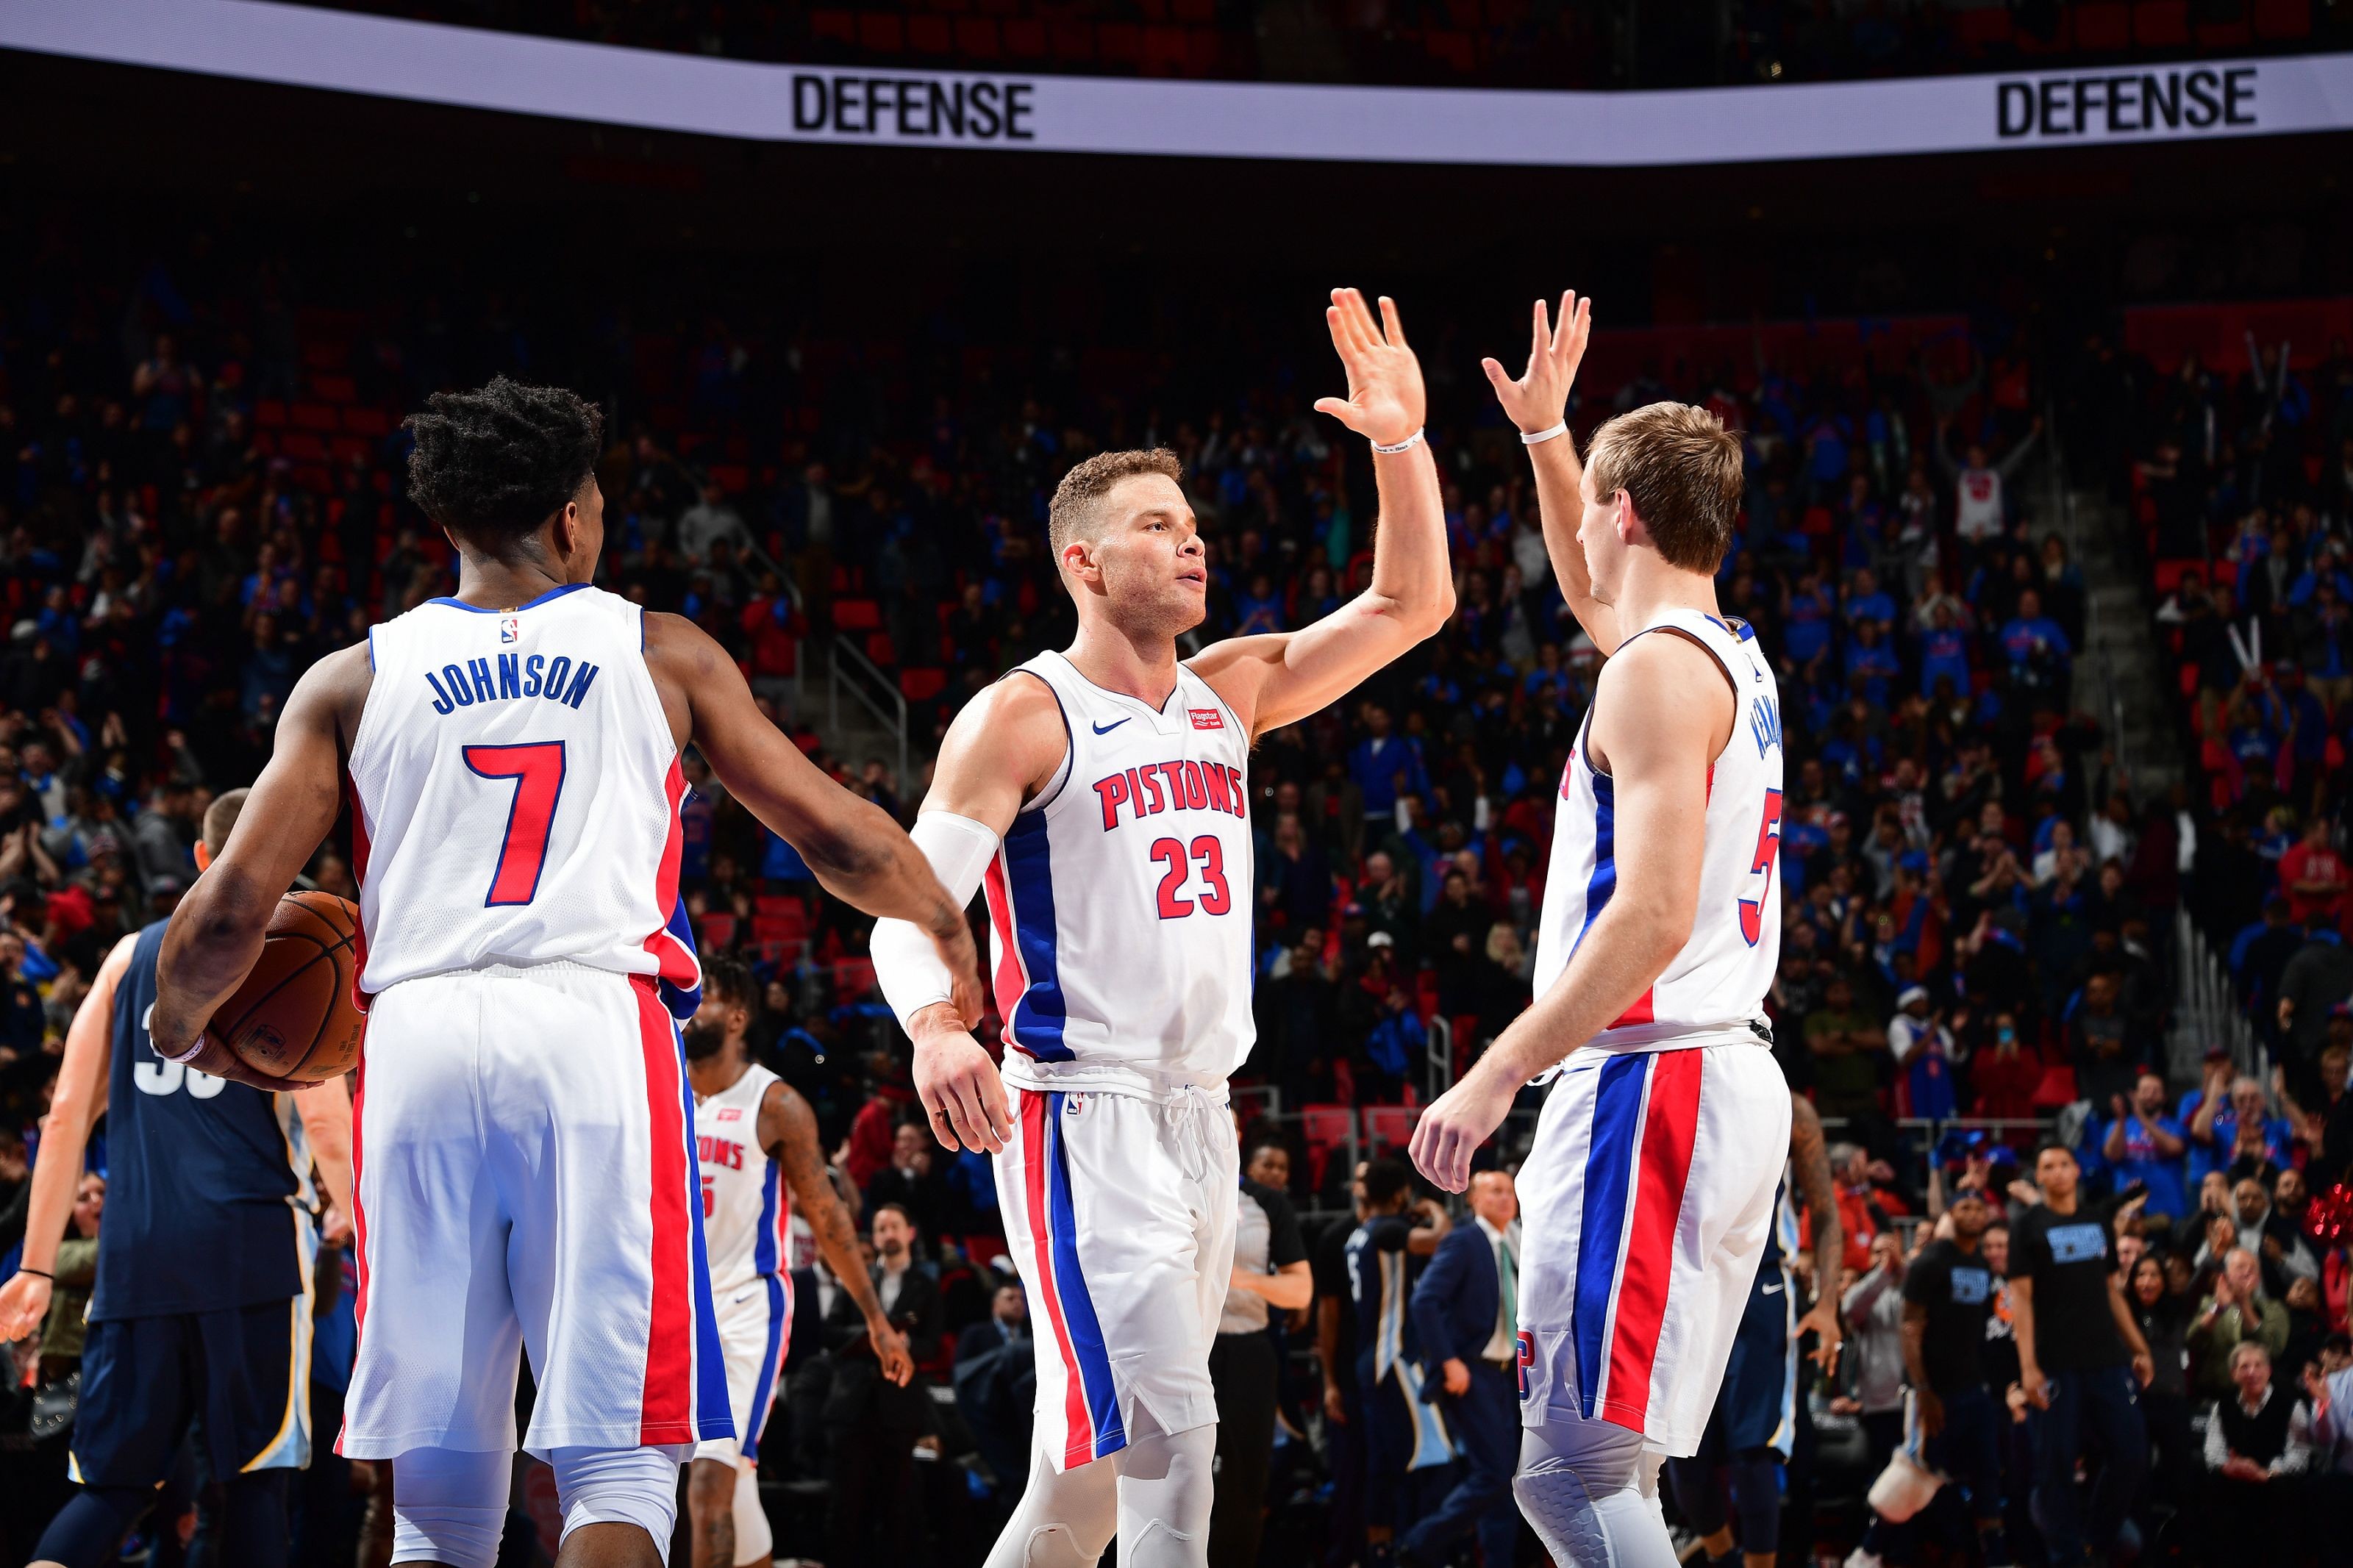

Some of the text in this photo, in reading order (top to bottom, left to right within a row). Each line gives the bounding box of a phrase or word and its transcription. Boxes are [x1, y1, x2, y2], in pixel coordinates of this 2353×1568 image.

[792, 75, 1034, 140] DEFENSE
[1997, 68, 2257, 136] DEFENSE
[425, 654, 599, 715] JOHNSON
[1190, 712, 1218, 720] Flagstar
[462, 740, 566, 908] 7
[1093, 760, 1245, 832] PISTONS
[1150, 835, 1231, 920] 23
[1737, 787, 1782, 948] 5
